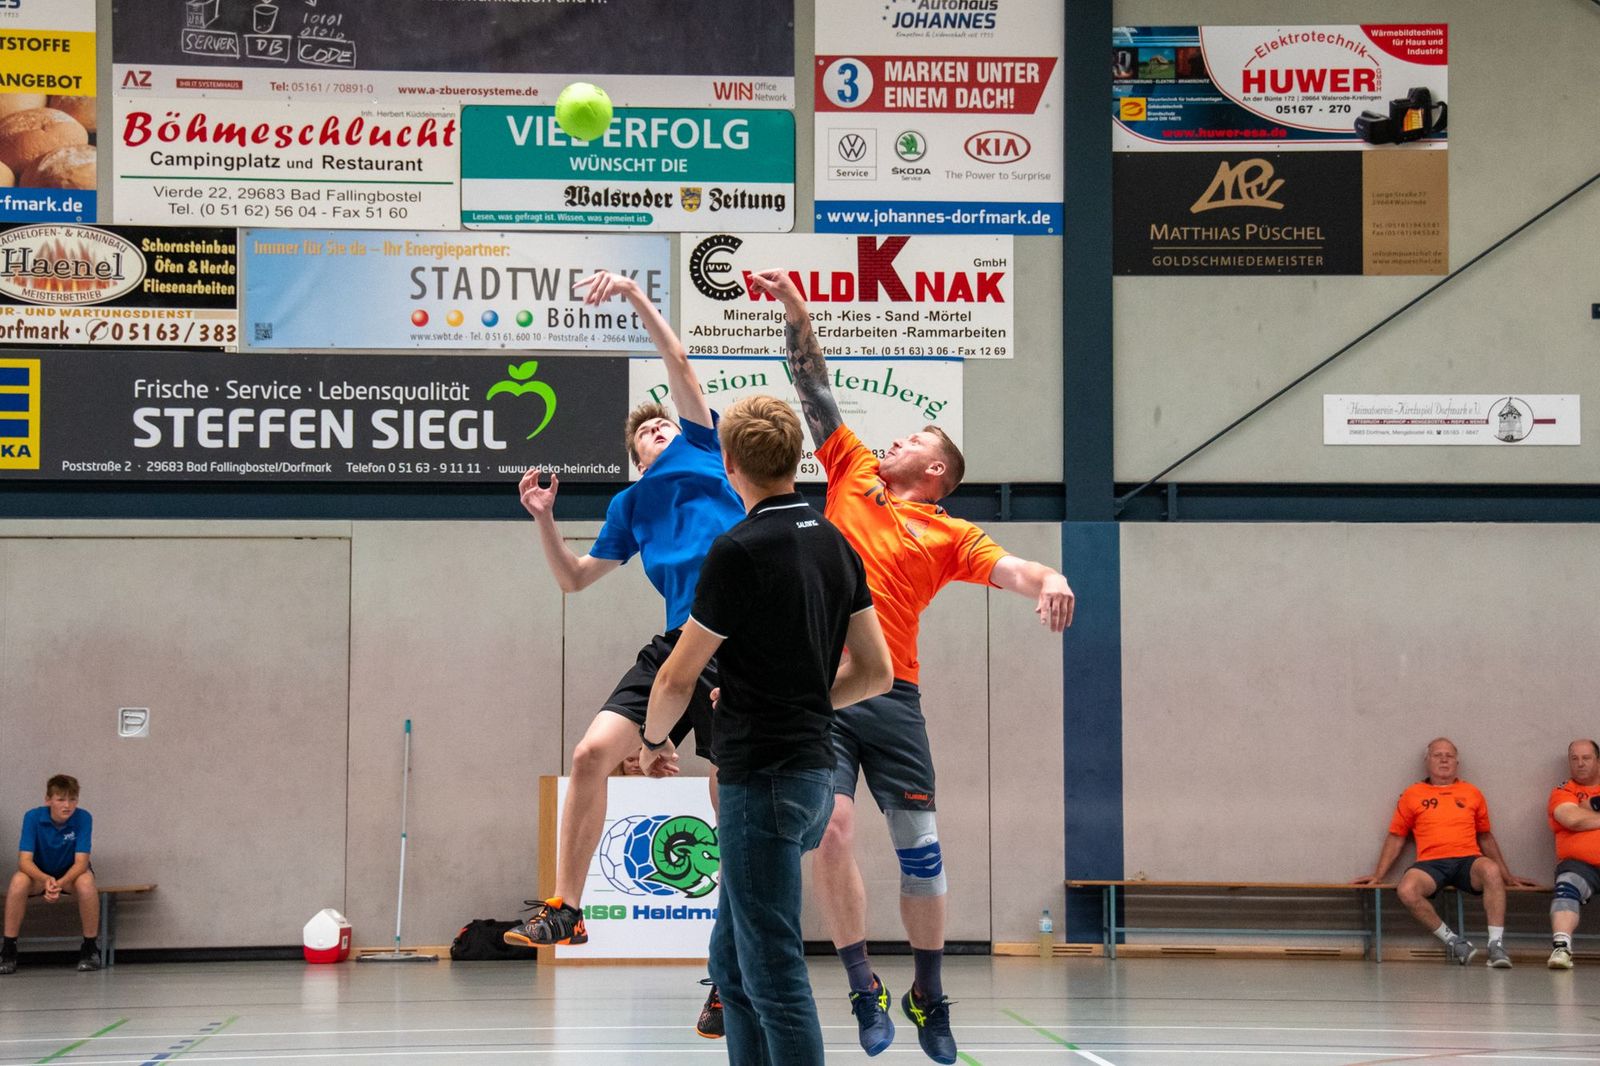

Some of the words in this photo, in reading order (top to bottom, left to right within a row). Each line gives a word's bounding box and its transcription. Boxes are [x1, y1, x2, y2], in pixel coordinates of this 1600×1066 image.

[892, 12, 996, 29] JOHANNES
[186, 33, 238, 52] SERVER
[256, 39, 284, 56] DB
[1255, 31, 1368, 59] Elektrotechnik
[300, 44, 352, 64] CODE
[884, 61, 968, 82] MARKEN
[977, 62, 1040, 83] UNTER
[1243, 68, 1375, 93] HUWER
[270, 82, 289, 92] Tel:
[291, 82, 322, 93] 05161
[398, 86, 538, 98] www.a-zbuerosysteme.de
[713, 82, 753, 101] WIN
[755, 82, 777, 91] Office
[837, 63, 859, 103] 3
[755, 93, 787, 101] Network
[884, 87, 947, 108] EINEM
[955, 88, 1015, 109] DACH!
[1276, 105, 1313, 114] 05167
[1329, 104, 1351, 113] 270
[123, 110, 456, 149] Böhmeschlucht
[603, 117, 750, 150] ERFOLG
[976, 138, 1020, 157] KIA
[150, 151, 281, 172] Campingplatz
[286, 158, 313, 170] und
[322, 154, 424, 172] Restaurant
[570, 154, 655, 173] WÜNSCHT
[661, 158, 688, 173] DIE
[836, 169, 869, 178] Service
[891, 167, 931, 175] ŠKODA
[945, 171, 963, 180] The
[965, 171, 995, 180] Power
[999, 172, 1009, 180] to
[1011, 172, 1051, 181] Surprise
[154, 186, 203, 199] Vierde
[238, 188, 286, 201] 29683
[291, 188, 321, 202] Bad
[327, 189, 422, 206] Fallingbostel
[564, 185, 674, 208] Walsroder
[708, 187, 786, 212] Zeitung
[168, 203, 194, 215] Tel.
[200, 203, 215, 217] (0
[220, 204, 238, 216] 51
[244, 204, 269, 218] 62)
[274, 205, 293, 217] 56
[298, 205, 317, 217] 04
[332, 206, 360, 218] Fax
[365, 207, 383, 218] 51
[389, 207, 408, 219] 60
[472, 212, 496, 221] Lesen,
[515, 213, 542, 222] gefragt
[544, 213, 557, 221] ist.
[558, 213, 585, 222] Wissen,
[604, 214, 634, 223] gemeint
[827, 208, 1051, 226] www.johannes-dorfmark.de
[1150, 223, 1240, 240] MATTHIAS
[1245, 223, 1325, 240] PÜSCHEL
[77, 230, 128, 253] KAMINBAU
[142, 238, 236, 255] Schornsteinbau
[254, 242, 300, 256] Immer
[303, 242, 323, 256] für
[326, 243, 346, 256] Sie
[349, 243, 366, 256] da
[384, 243, 402, 256] Ihr
[405, 242, 511, 260] Energiepartner:
[1, 247, 126, 281] Haenel
[155, 256, 185, 274] Öfen
[188, 262, 198, 273] &
[201, 262, 236, 275] Herde
[857, 236, 1006, 303] KNAK
[973, 258, 1007, 268] GmbH
[1152, 255, 1324, 267] GOLDSCHMIEDEMEISTER
[144, 279, 236, 295] Fliesenarbeiten
[410, 266, 662, 303] STADTWEE
[22, 288, 102, 302] MEISTERBETRIEB
[25, 308, 56, 316] UND
[60, 309, 194, 319] WARTUNGSDIENST
[548, 307, 661, 329] Böhmet
[724, 309, 832, 323] Mineralgesch
[885, 310, 919, 322] Sand
[410, 333, 463, 342] www.swbt.de
[470, 333, 482, 342] Tel.
[548, 333, 588, 343] Poststraße
[602, 335, 626, 343] 29664
[688, 326, 788, 338] -Abbrucharbei
[688, 346, 719, 355] 29683
[722, 345, 769, 355] Dorfmark
[861, 347, 877, 355] Tel.
[881, 347, 891, 356] (0
[894, 347, 905, 355] 51
[909, 347, 925, 356] 63)
[958, 347, 976, 355] Fax
[980, 347, 990, 355] 12
[994, 347, 1006, 355] 69
[134, 379, 209, 399] Frische
[226, 380, 302, 400] Service
[318, 381, 470, 405] Lebensqualität
[646, 369, 768, 405] Psion
[780, 360, 948, 421] tenberg
[133, 407, 354, 449] STEFFEN
[371, 409, 507, 450] SIEGL
[1, 444, 32, 458] KA
[62, 461, 122, 472] Poststraße
[124, 461, 132, 472] 2
[147, 462, 184, 472] 29683
[186, 462, 208, 473] Bad
[210, 461, 332, 475] Fallingbostel/Dorfmark
[346, 462, 385, 474] Telefon
[388, 463, 395, 473] 0
[399, 463, 412, 473] 51
[416, 463, 430, 473] 63
[439, 463, 447, 474] 9
[450, 463, 463, 474] 11
[467, 463, 480, 474] 11
[1422, 798, 1438, 810] 99
[633, 905, 719, 920] Heidma
